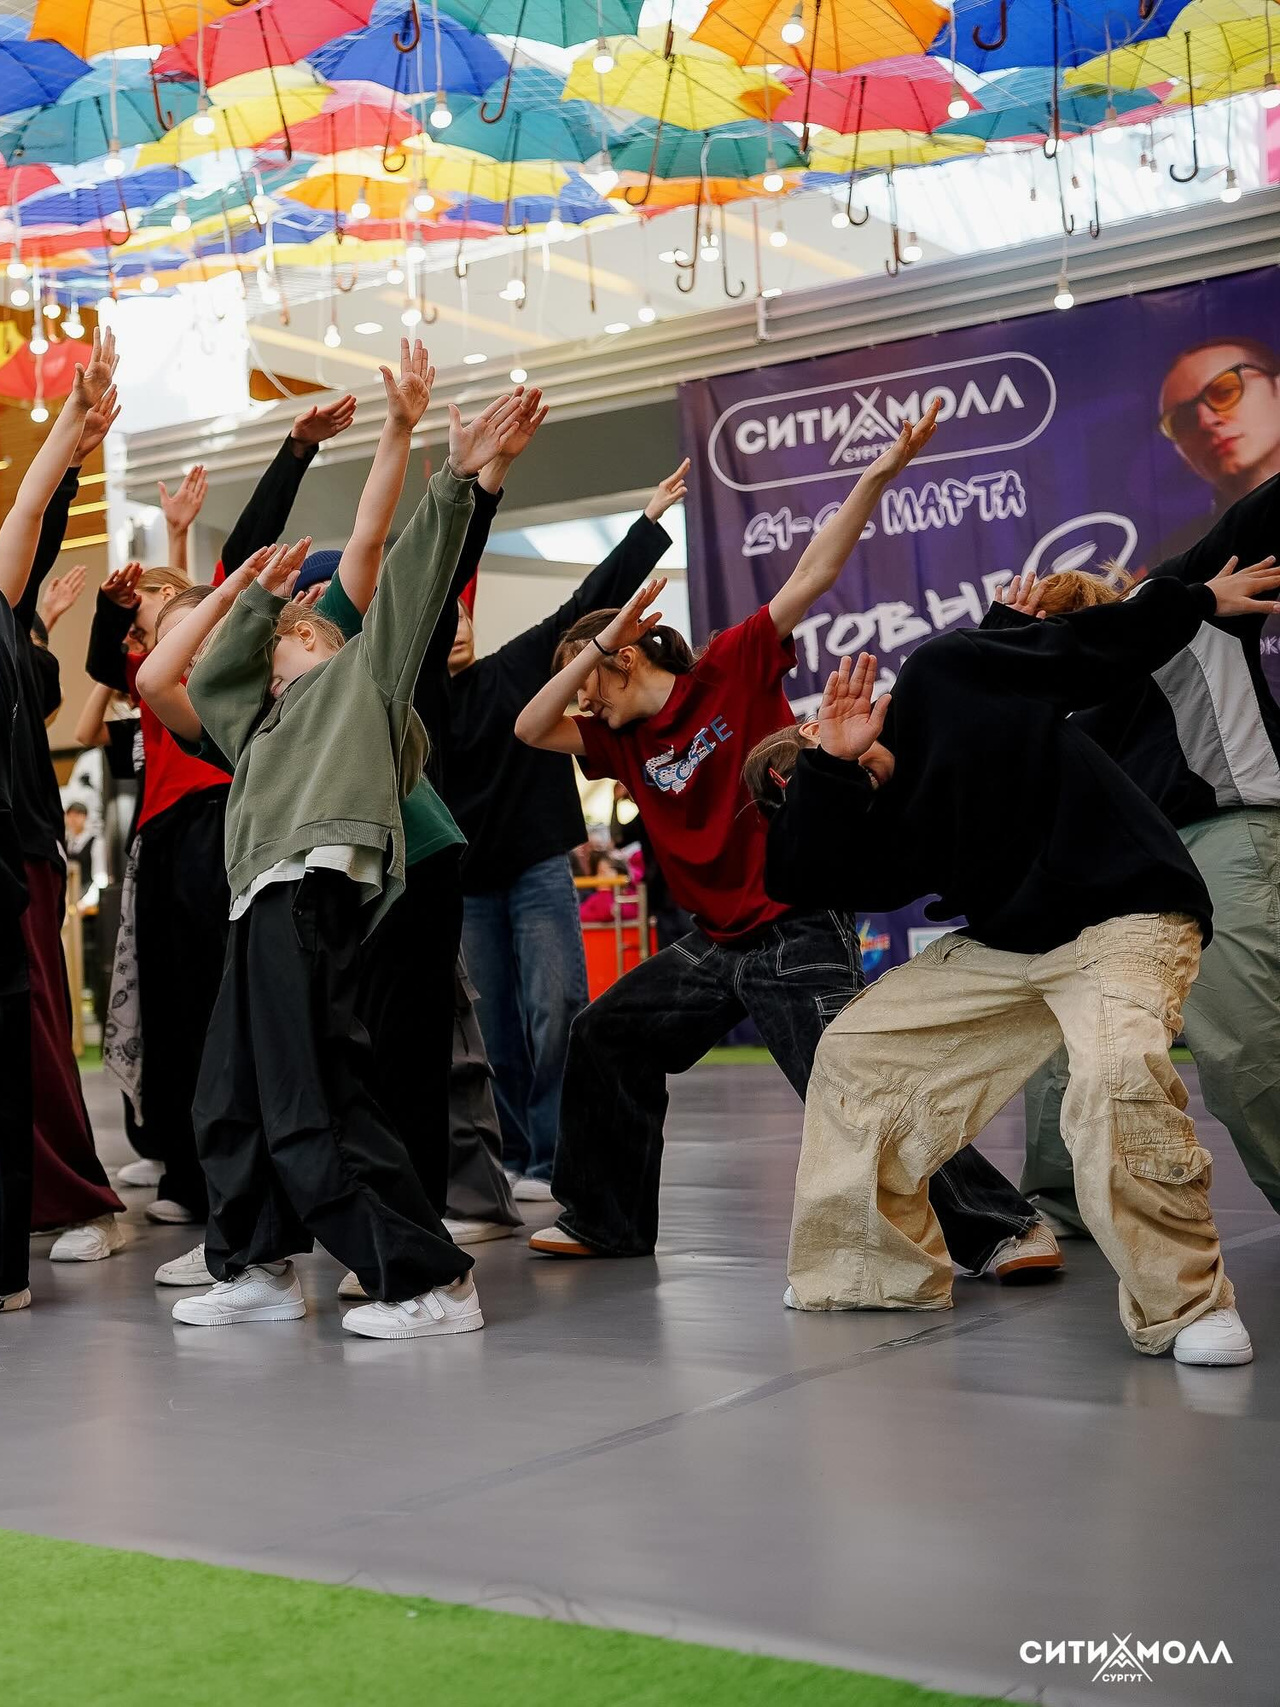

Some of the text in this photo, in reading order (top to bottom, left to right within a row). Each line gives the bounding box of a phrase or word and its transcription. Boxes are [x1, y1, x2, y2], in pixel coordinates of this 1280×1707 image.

[735, 373, 1025, 455] СИТИ МОЛЛ
[880, 469, 1027, 536] МАРТА
